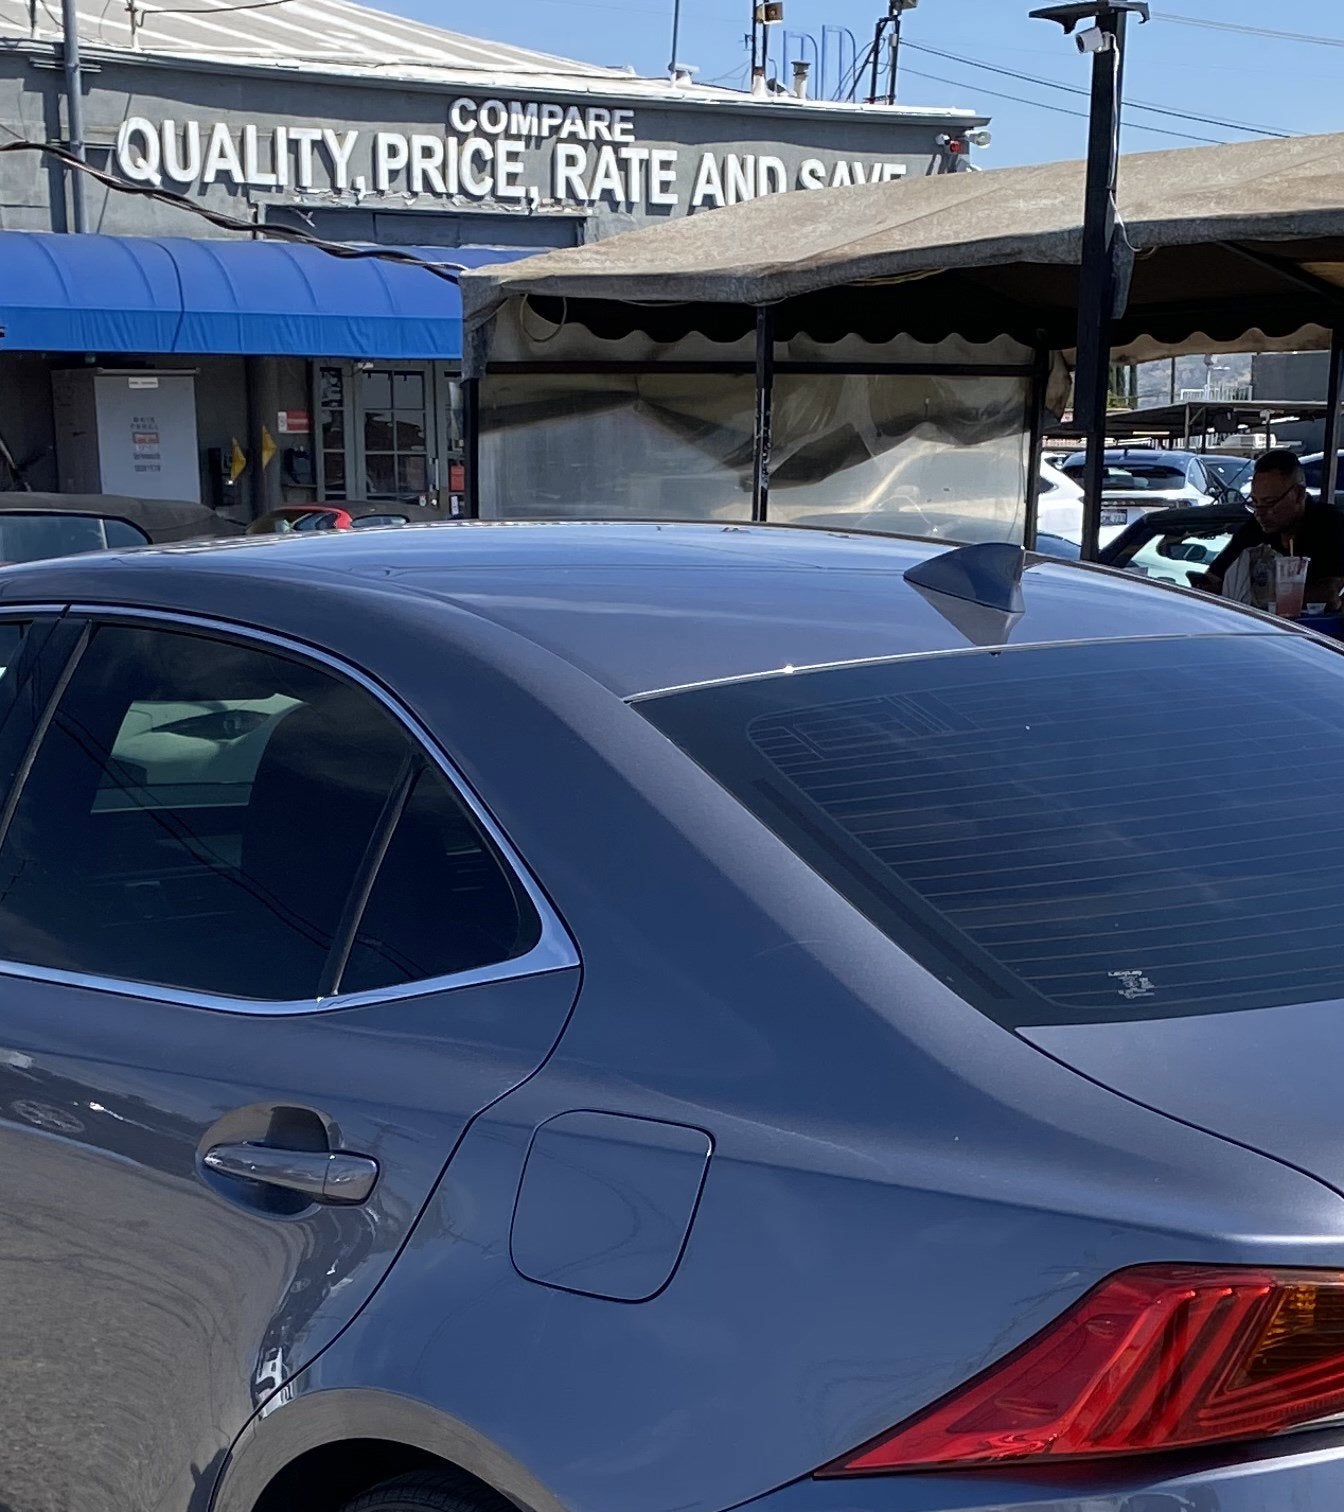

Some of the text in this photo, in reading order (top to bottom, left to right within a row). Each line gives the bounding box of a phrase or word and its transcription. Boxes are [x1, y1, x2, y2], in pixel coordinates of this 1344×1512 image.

[449, 97, 635, 143] COMPARE
[117, 117, 365, 198] QUALITY,
[375, 131, 541, 210] PRICE,
[555, 143, 678, 205] RATE
[692, 153, 787, 207] AND
